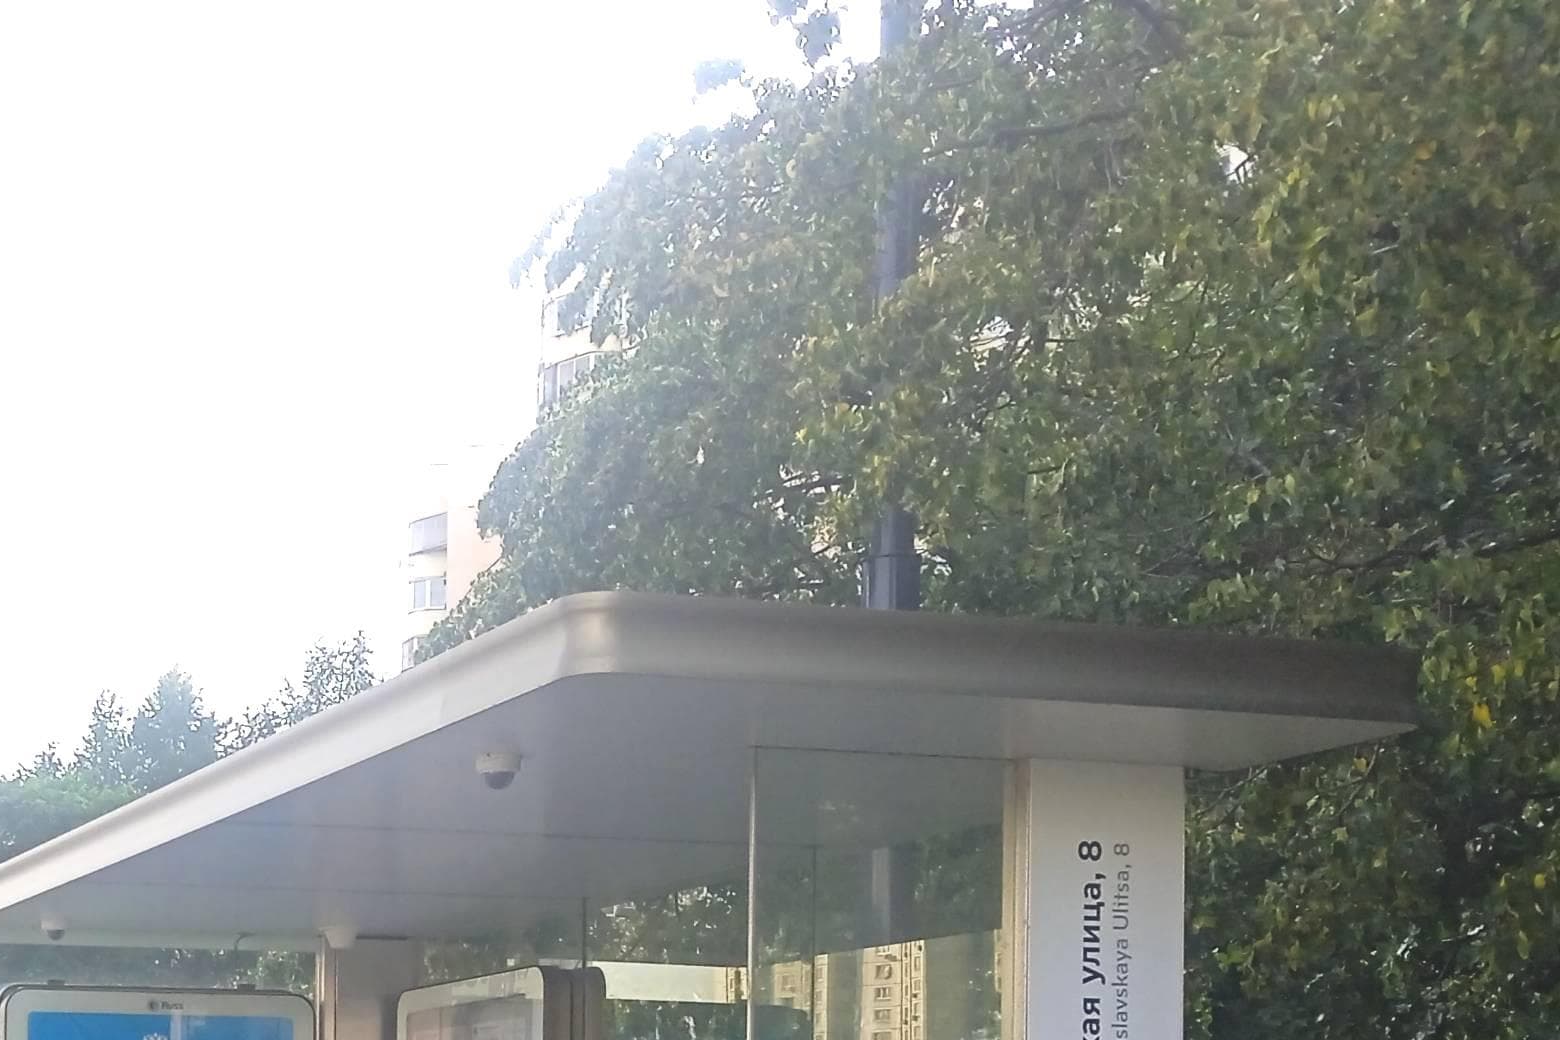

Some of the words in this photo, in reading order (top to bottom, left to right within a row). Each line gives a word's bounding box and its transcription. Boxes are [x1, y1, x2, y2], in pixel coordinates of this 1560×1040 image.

[1078, 841, 1102, 861] 8
[1113, 843, 1129, 856] 8
[1112, 864, 1132, 930] Ulitsa,
[1082, 873, 1106, 985] улица,
